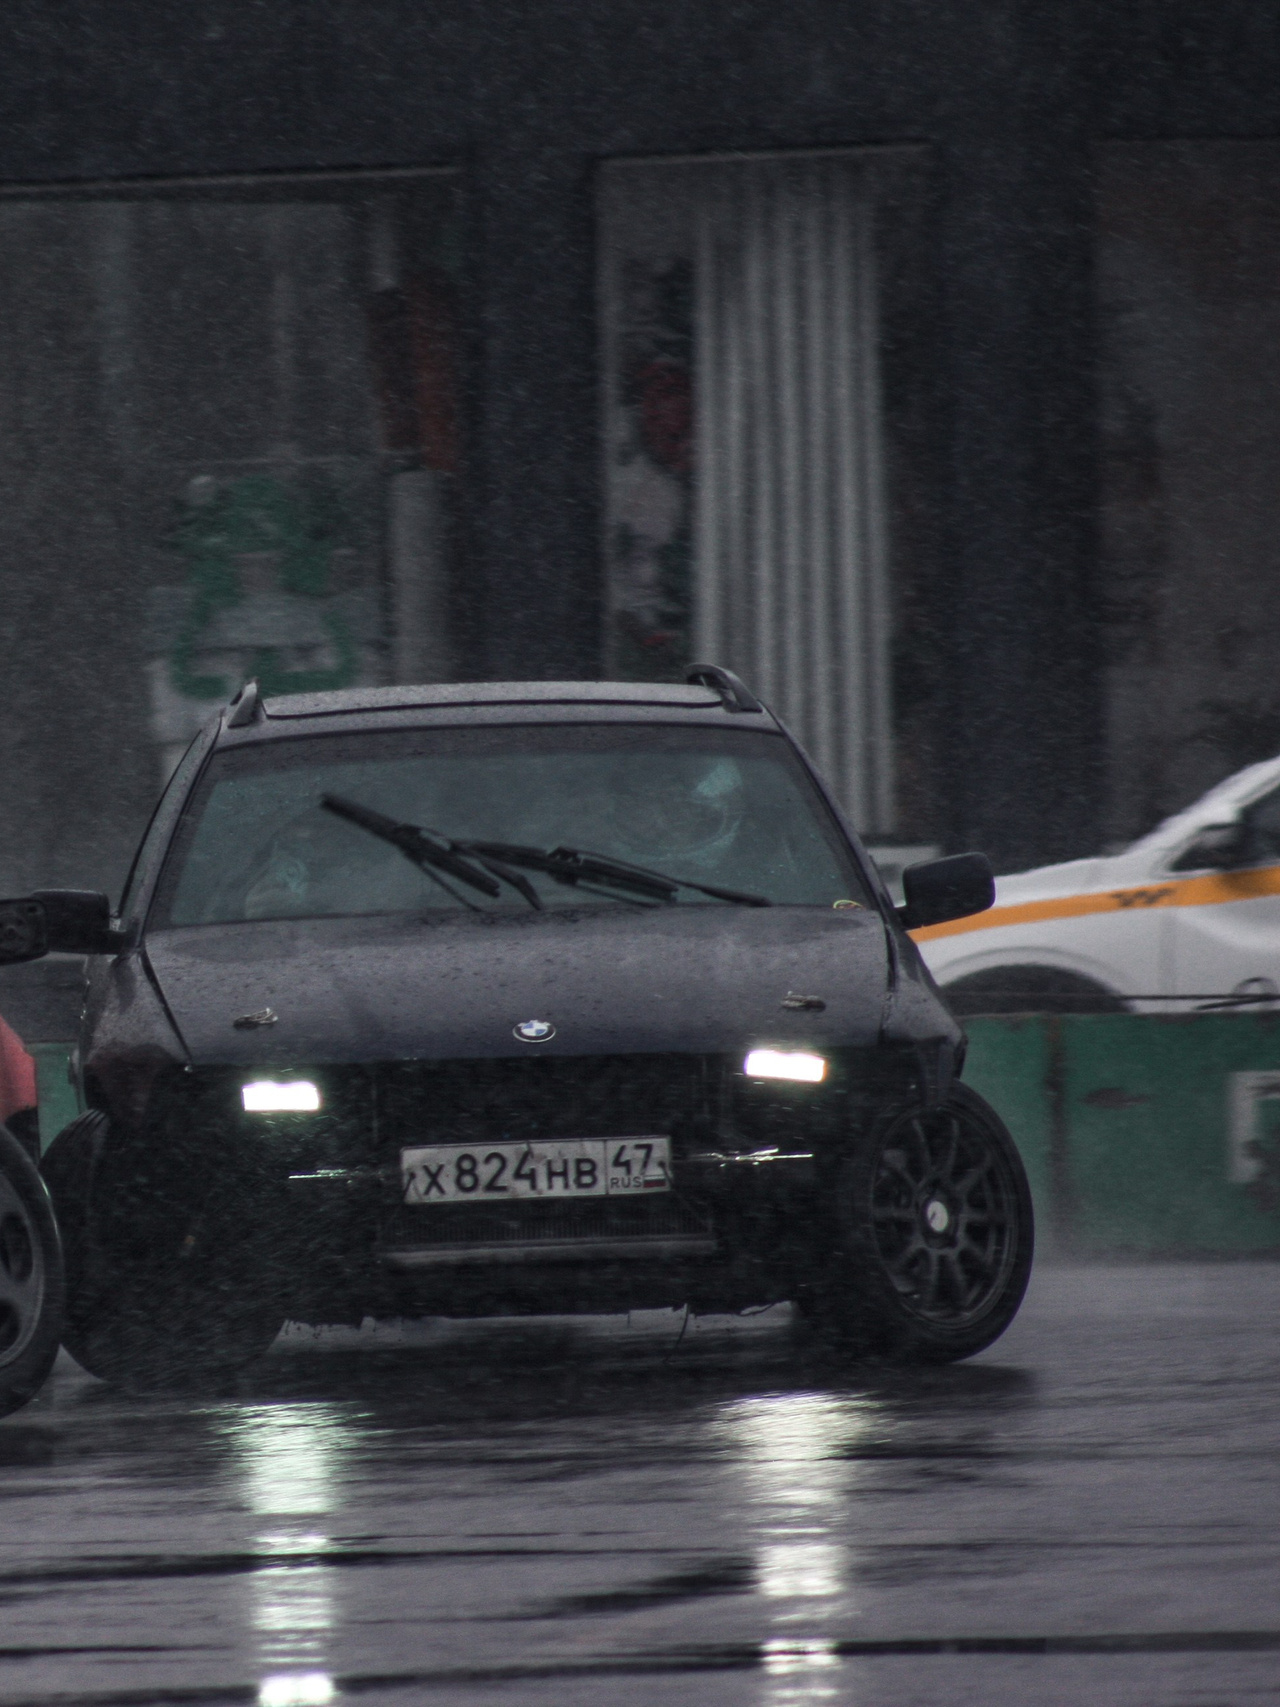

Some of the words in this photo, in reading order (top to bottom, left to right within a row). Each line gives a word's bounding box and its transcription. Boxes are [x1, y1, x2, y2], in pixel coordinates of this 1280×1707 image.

[422, 1150, 598, 1196] X824HB
[612, 1143, 653, 1175] 47
[610, 1176, 642, 1188] RUS
